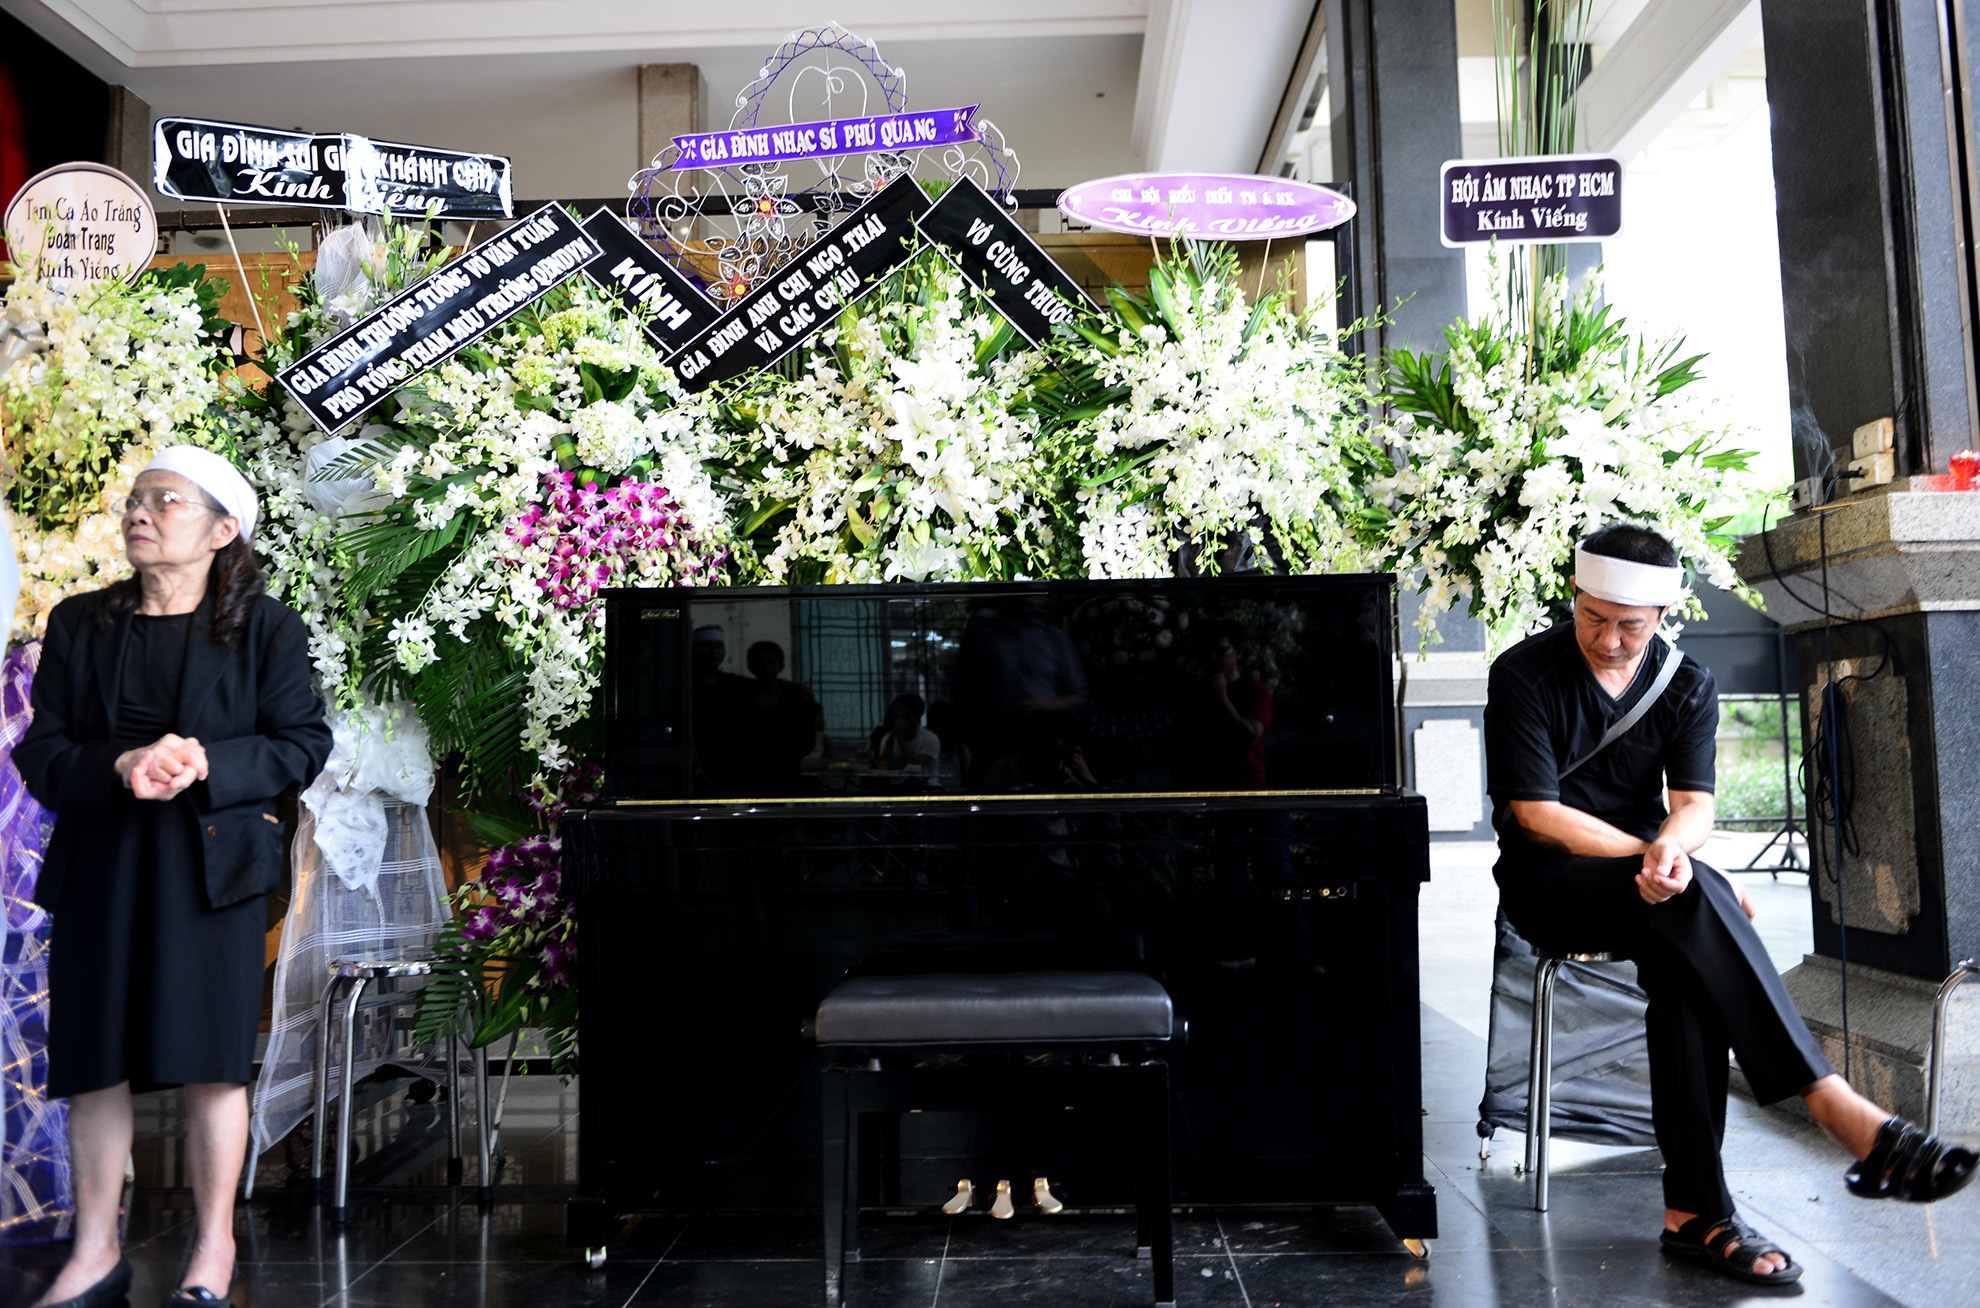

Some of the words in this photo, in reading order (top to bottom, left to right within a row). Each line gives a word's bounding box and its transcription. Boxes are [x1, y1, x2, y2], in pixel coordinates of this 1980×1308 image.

[772, 129, 817, 156] NHẠC
[819, 121, 838, 150] SĨ
[843, 117, 876, 148] PHÚ
[881, 118, 937, 148] QUANG
[176, 130, 216, 163] GIA
[221, 130, 278, 168] ĐÌNH
[324, 145, 360, 178] GI
[374, 150, 448, 185] KHÁNH
[232, 168, 334, 199] Kính
[1451, 172, 1480, 208] HỘI
[1482, 171, 1507, 202] ÂM
[1510, 174, 1553, 205] NHẠC
[1556, 173, 1577, 198] TP
[1578, 171, 1615, 197] HCM
[55, 197, 75, 221] Ca
[80, 193, 98, 221] Áo
[103, 199, 142, 233] Trắng
[1477, 208, 1525, 231] Kính
[1531, 204, 1588, 232] Viếng
[81, 227, 116, 255] Trang
[609, 256, 692, 331] KÍNH
[966, 217, 995, 245] VÔ
[986, 240, 1031, 285] CÙNG
[1024, 279, 1080, 334] THƯƠ
[706, 317, 749, 358] ĐÌNH
[747, 291, 782, 328] ANH
[778, 269, 813, 301] CHỊ
[806, 244, 845, 280] NGỌ
[753, 326, 783, 354] VÀ
[779, 302, 816, 337] CÁC
[814, 266, 860, 310] CHÁU
[316, 337, 365, 377] ĐÌNH
[322, 380, 365, 419] PHÓ
[401, 327, 449, 369] THAM
